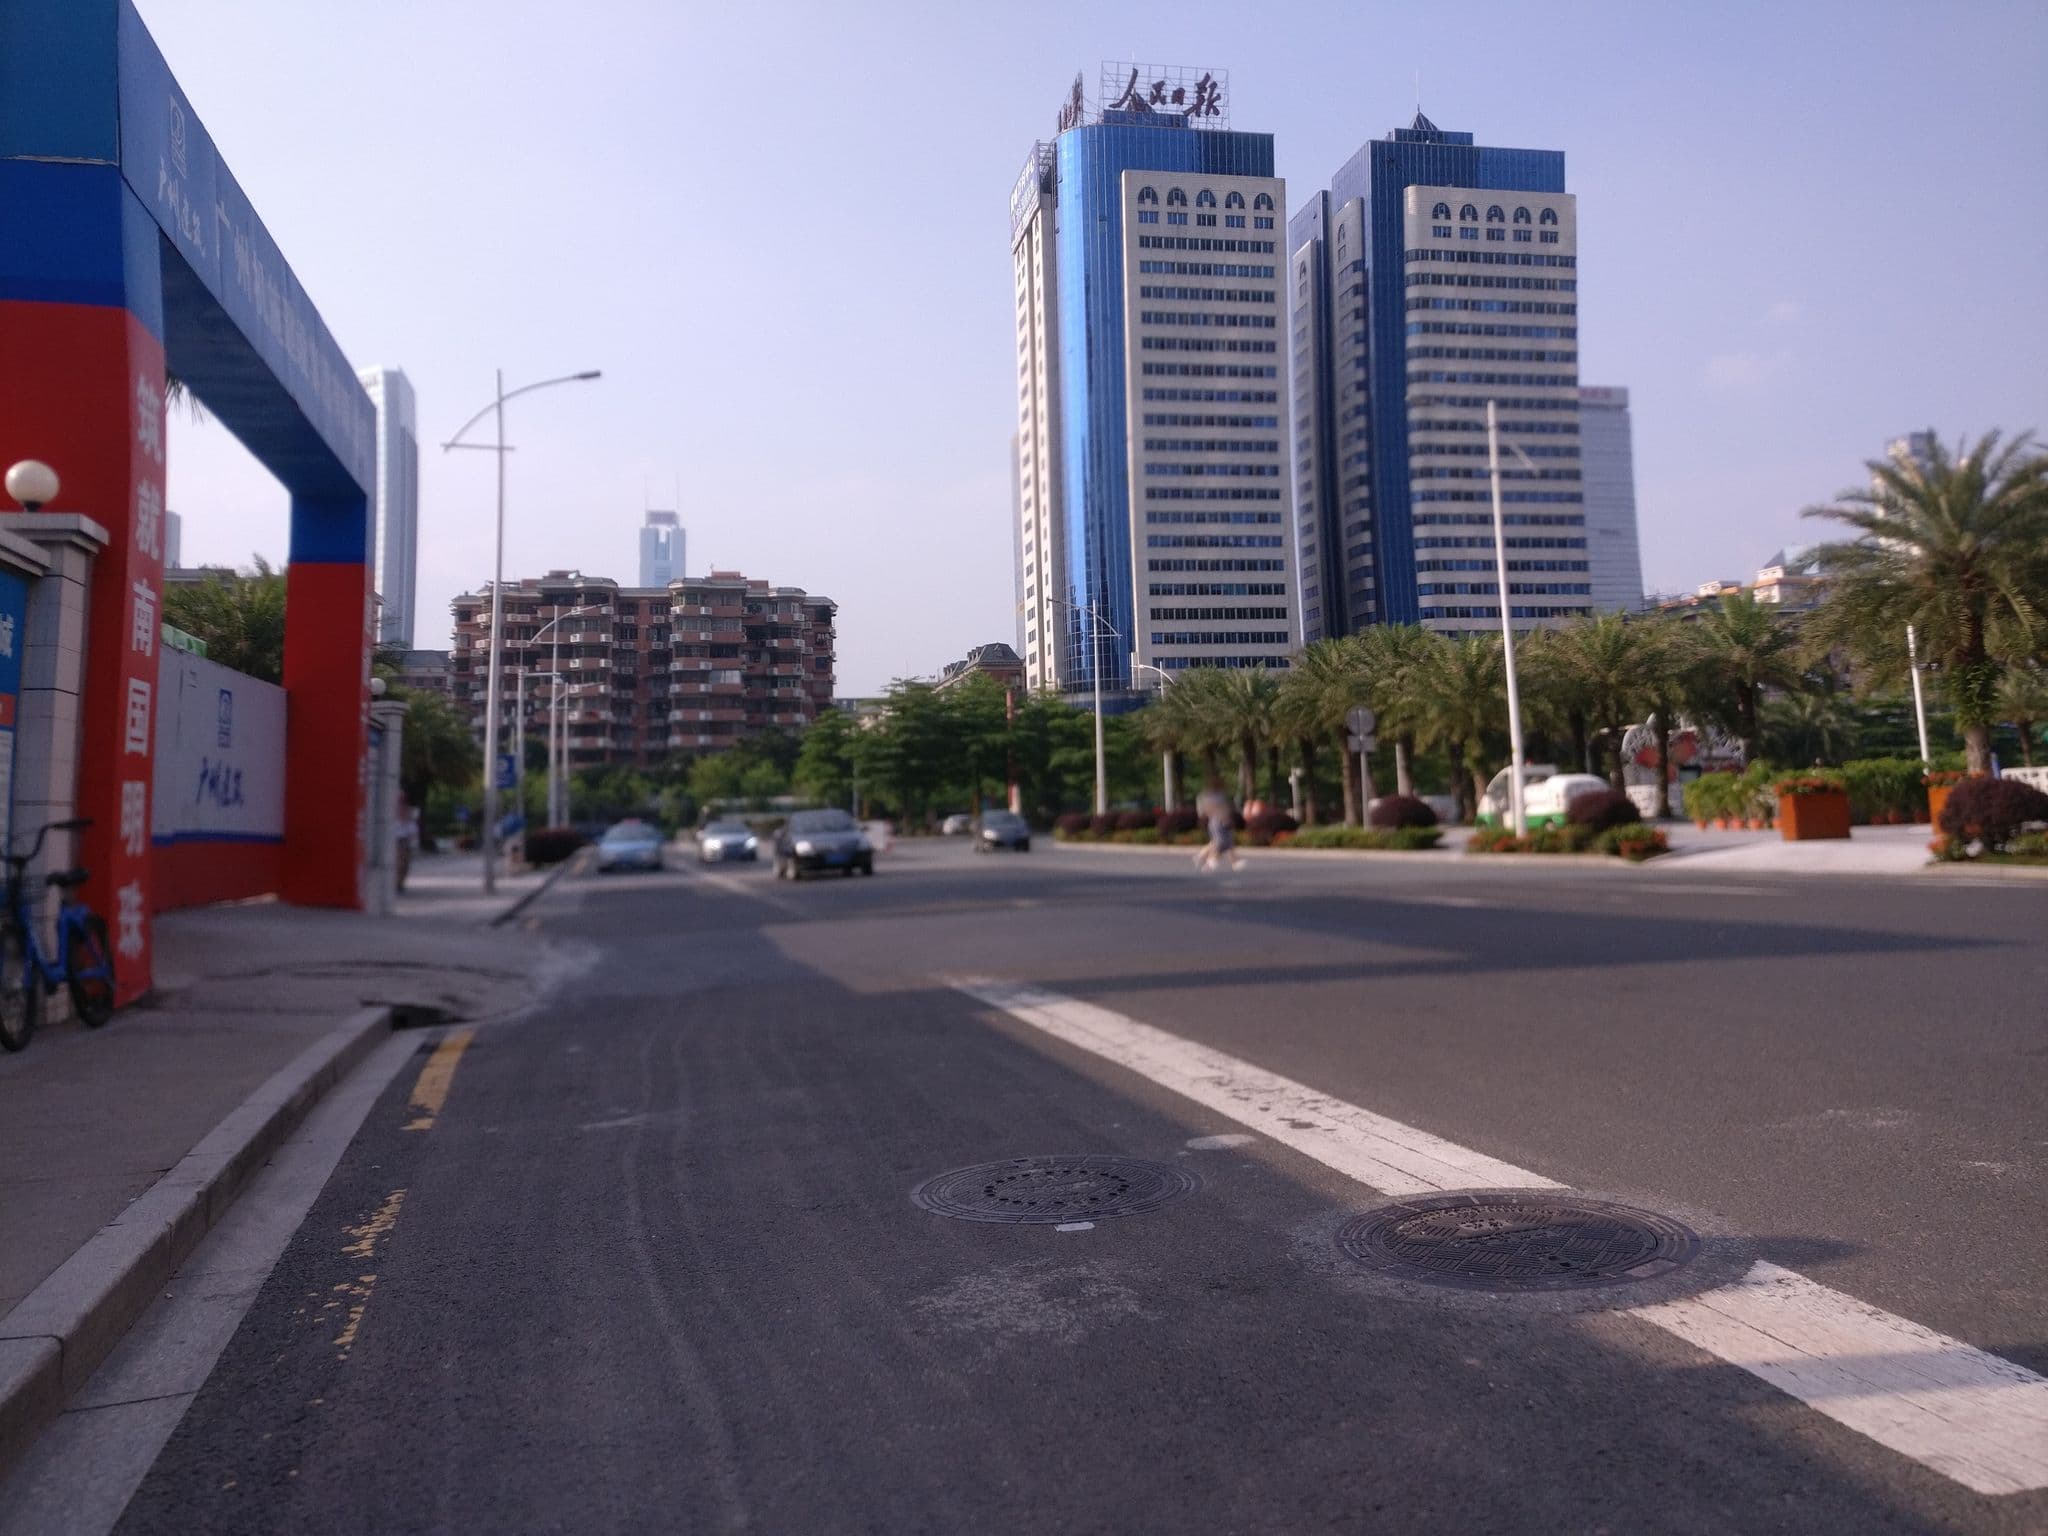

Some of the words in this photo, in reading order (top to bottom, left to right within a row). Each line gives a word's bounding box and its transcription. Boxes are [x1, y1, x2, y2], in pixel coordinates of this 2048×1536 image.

[1109, 67, 1221, 117] 人民日报
[117, 375, 163, 960] 筑就南国明珠
